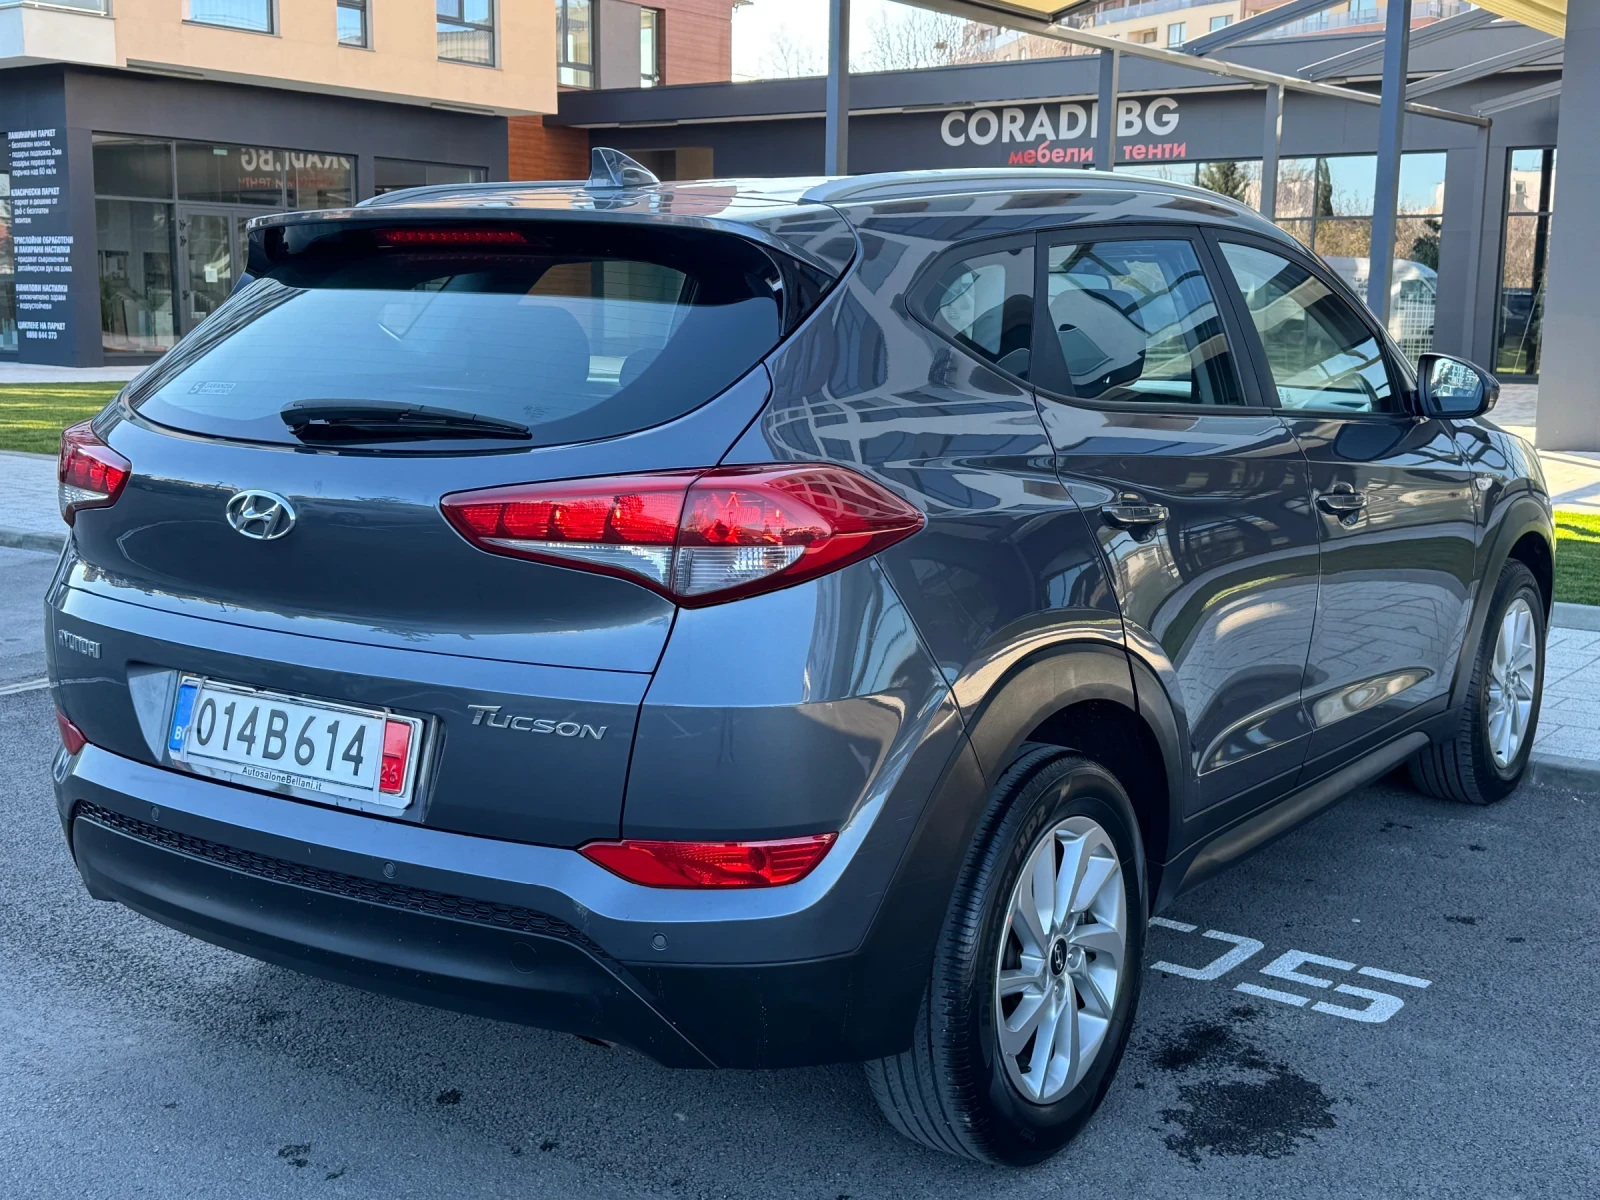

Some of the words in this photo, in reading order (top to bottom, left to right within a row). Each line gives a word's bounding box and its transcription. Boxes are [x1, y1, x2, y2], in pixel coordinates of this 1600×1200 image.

[38, 128, 56, 138] ПАРКЕТ
[1008, 140, 1094, 165] мебели
[1123, 142, 1186, 160] тенти
[42, 186, 60, 196] ПАРКЕТ
[40, 322, 47, 330] НА
[47, 322, 66, 330] ПАРКЕТ
[58, 629, 100, 659] HYUNDAI
[196, 697, 366, 777] 014B614
[241, 766, 322, 791] AutosaloneBellani.it
